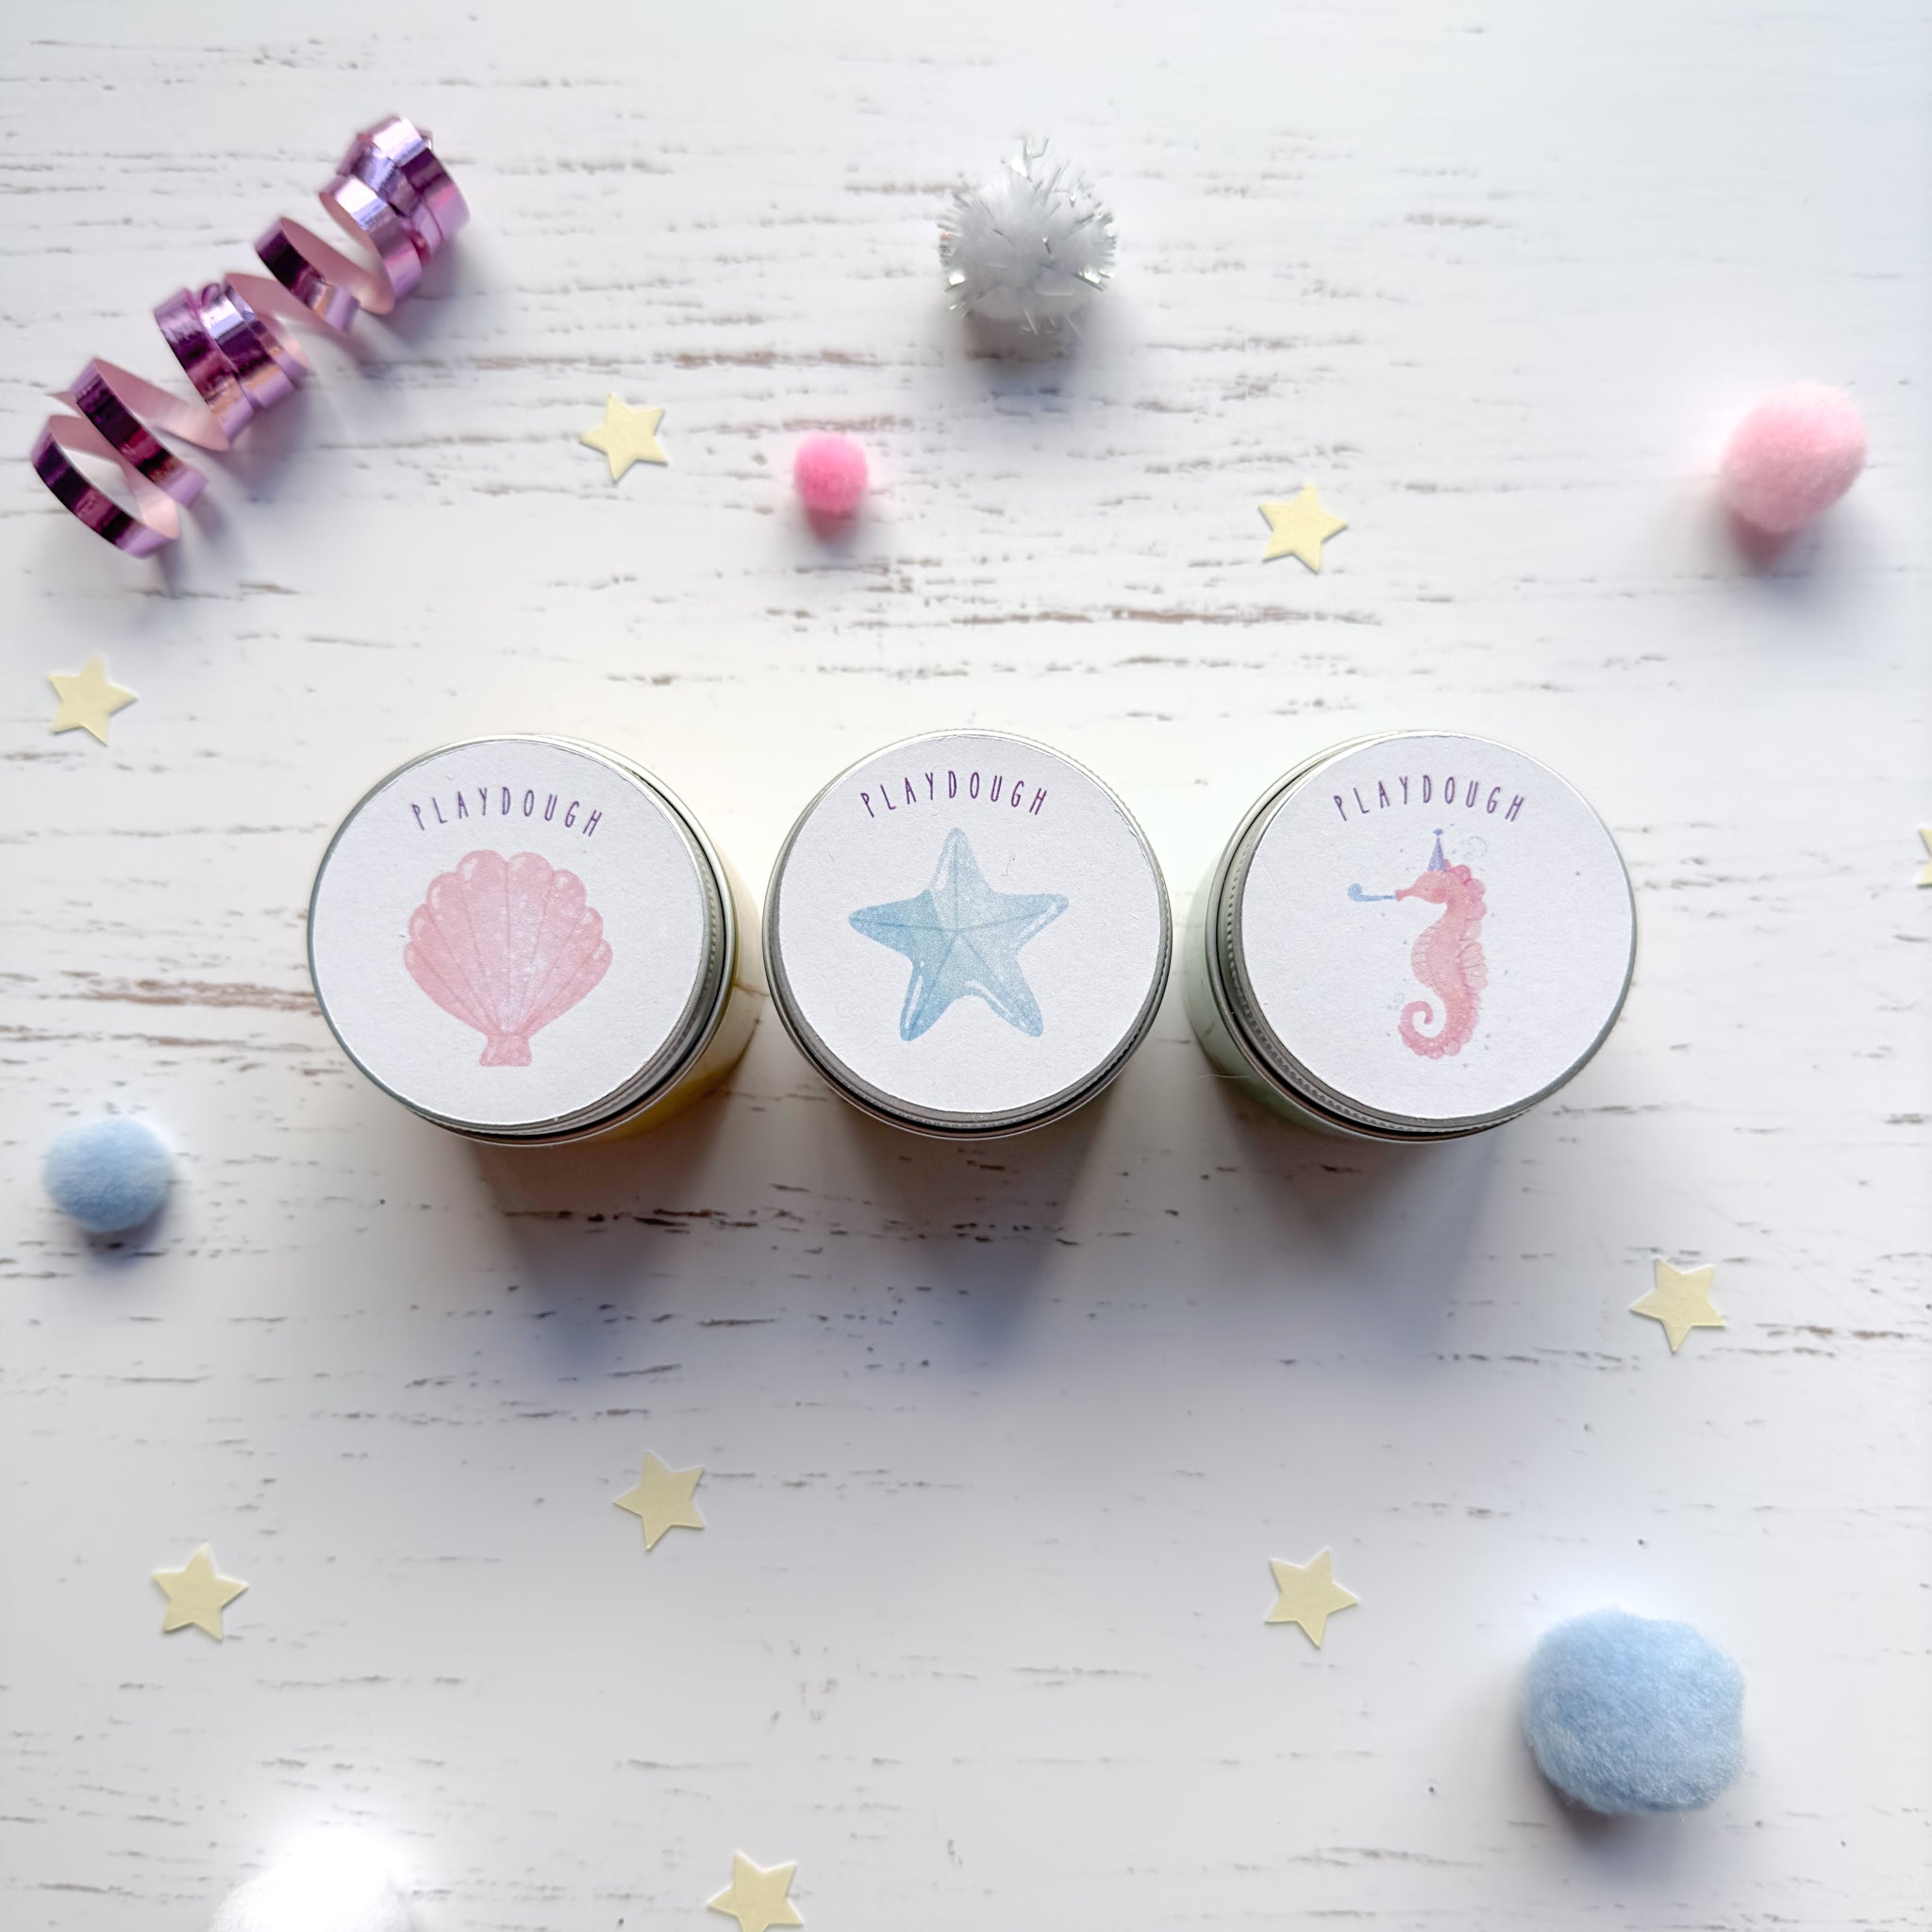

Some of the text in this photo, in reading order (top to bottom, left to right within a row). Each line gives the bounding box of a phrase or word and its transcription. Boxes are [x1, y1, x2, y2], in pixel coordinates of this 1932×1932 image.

[411, 786, 604, 838] PLAYDOUGH
[859, 770, 1048, 818] PLAYDOUGH
[1333, 774, 1524, 822] PLAYDOUGH
